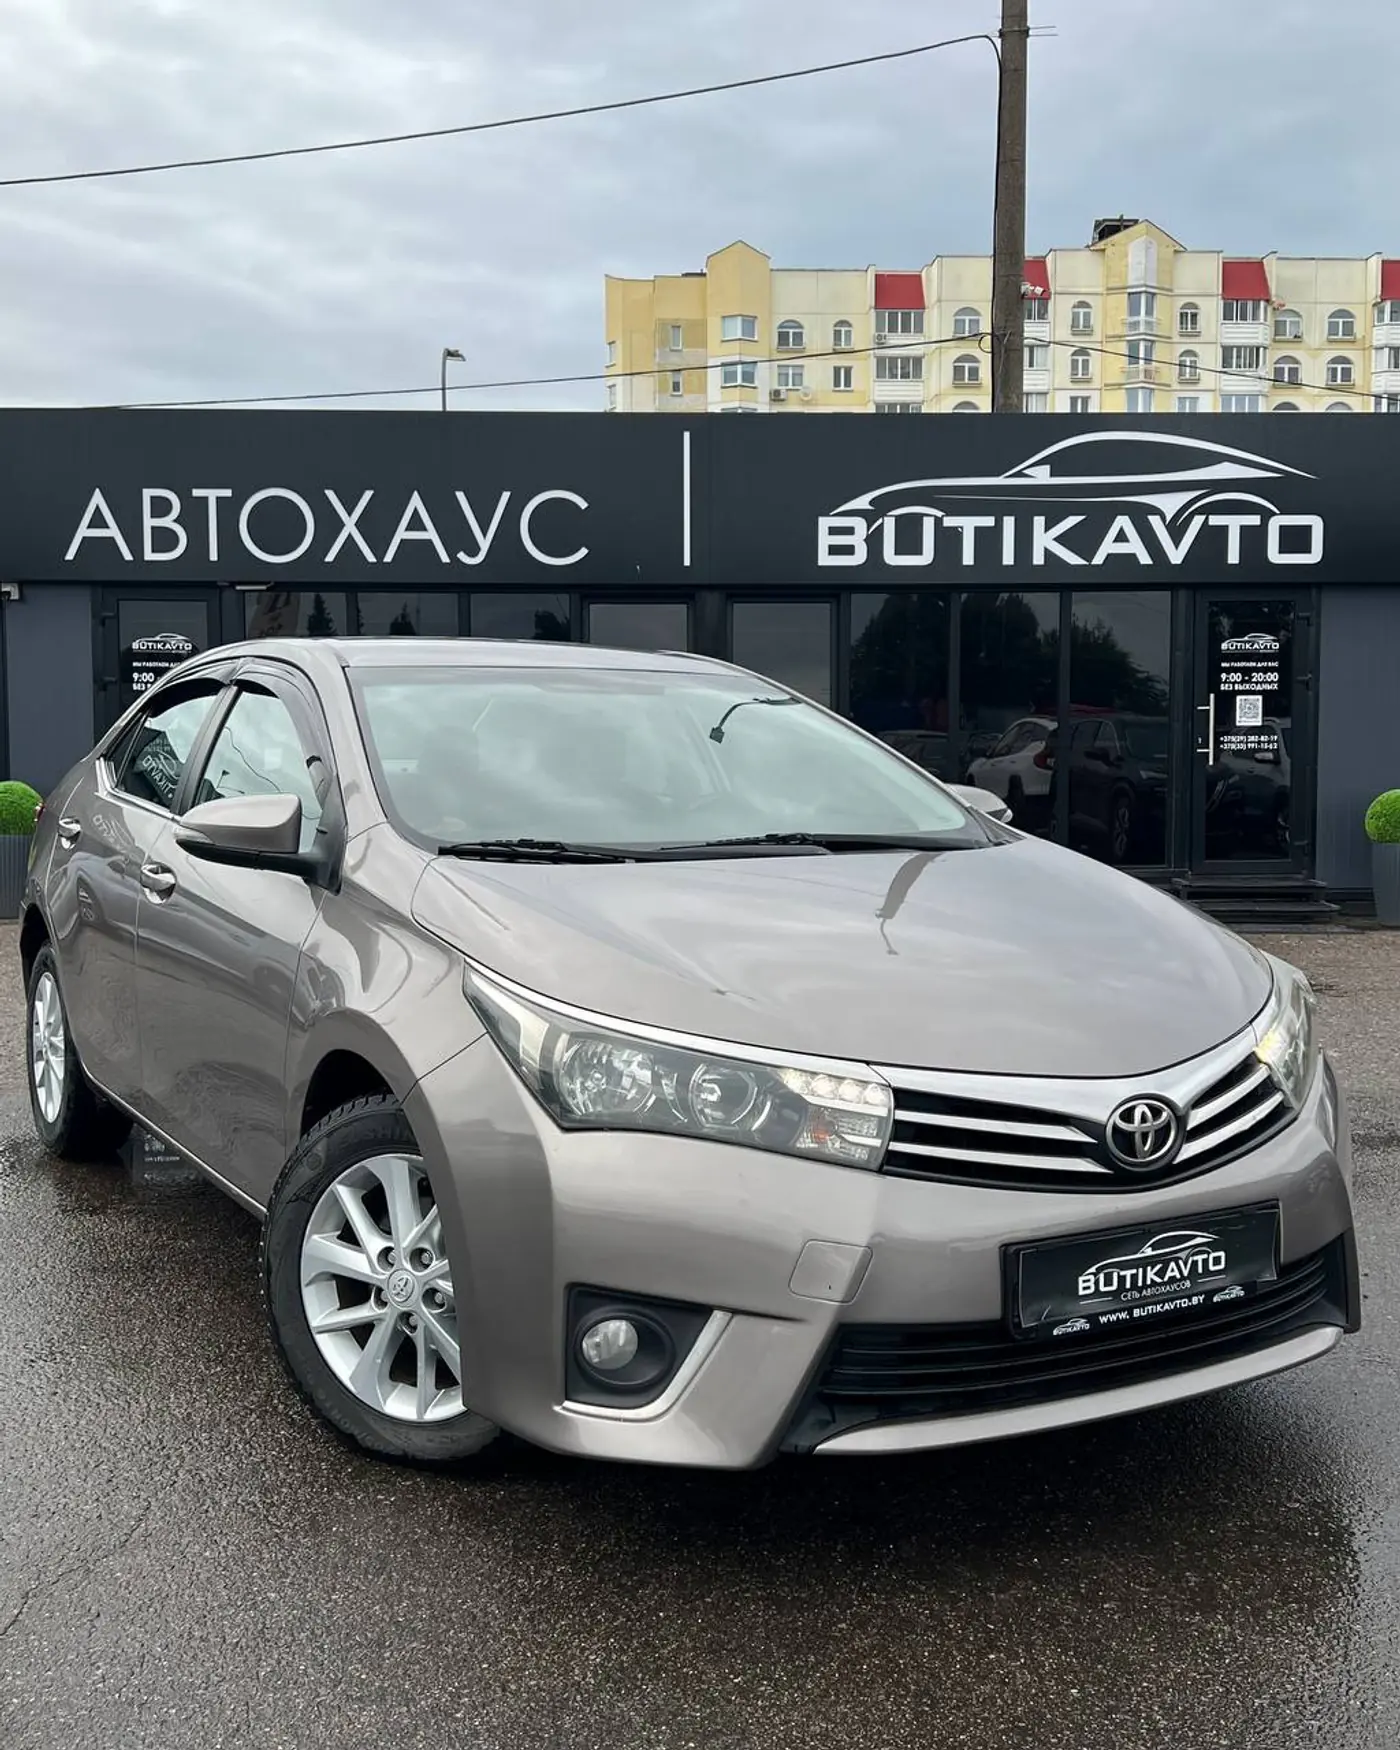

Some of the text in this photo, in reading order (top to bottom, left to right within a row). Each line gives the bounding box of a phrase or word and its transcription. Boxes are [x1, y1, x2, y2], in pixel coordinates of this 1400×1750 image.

[65, 487, 589, 566] АВТОХАУС
[817, 514, 1325, 567] BUTIKAVTO
[132, 641, 192, 650] BUTIKAVTO
[1221, 642, 1280, 650] BUTIKAVTO
[132, 672, 155, 682] 9:00
[1220, 672, 1242, 682] 9:00
[1251, 672, 1279, 682] 20:00
[1220, 683, 1279, 691] БЕЗ ВЫХОДНЫХ
[1077, 1250, 1225, 1296] BUTIKAVTO
[1120, 1279, 1192, 1301] СЕТЬ АВТОХАУСОВ
[1098, 1294, 1206, 1325] WWW. BUTIKAVTO.BY
